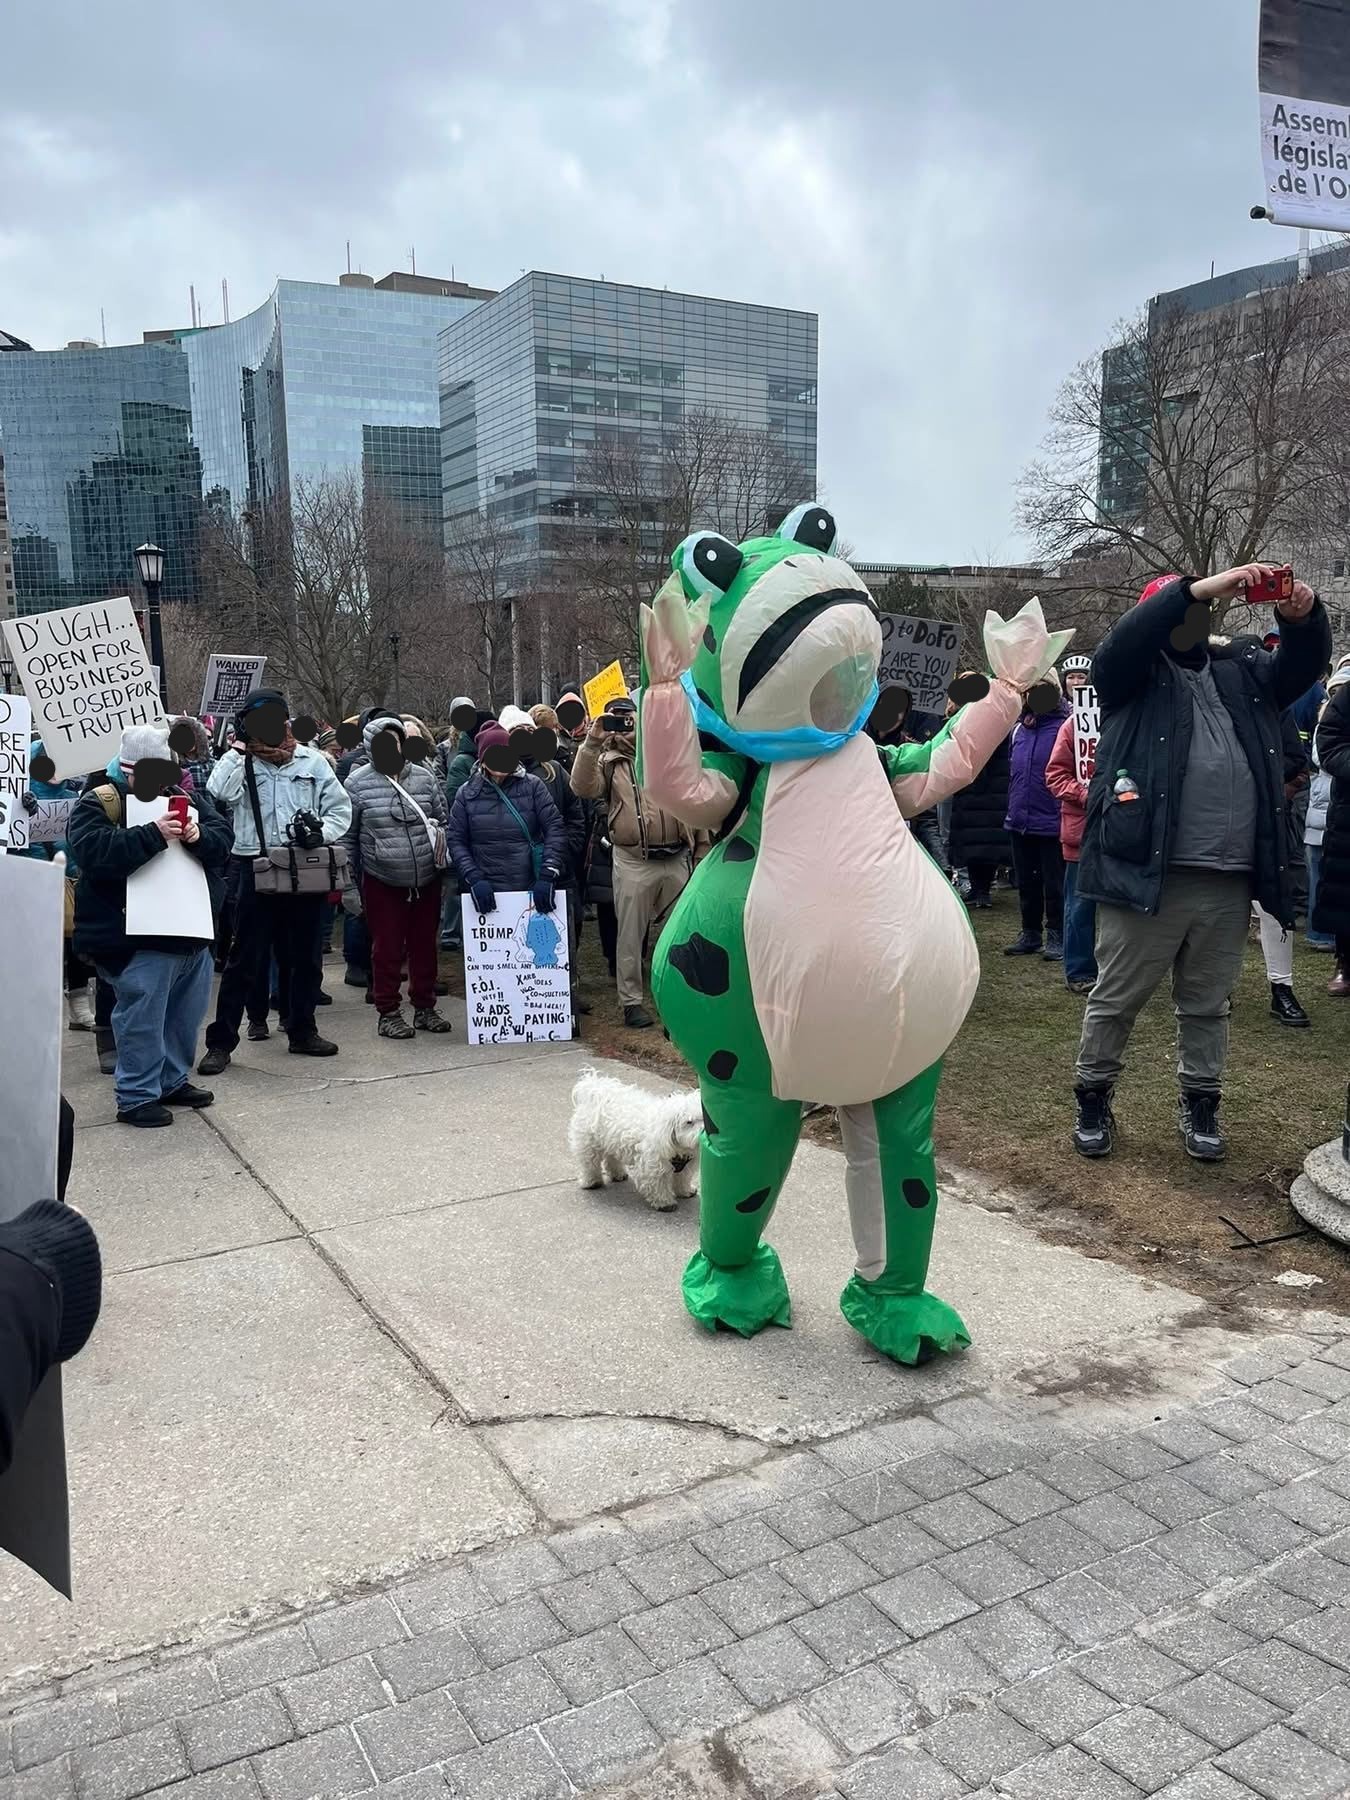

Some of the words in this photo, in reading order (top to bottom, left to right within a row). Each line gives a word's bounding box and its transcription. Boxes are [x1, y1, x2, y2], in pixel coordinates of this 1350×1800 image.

[1272, 104, 1350, 138] Assem
[1278, 169, 1307, 194] de
[1313, 172, 1350, 199] l'O
[898, 621, 913, 638] to
[27, 649, 88, 676] OPEN
[92, 639, 140, 663] FOR
[215, 660, 259, 670] WANTED
[891, 651, 920, 669] ARE
[924, 654, 951, 676] YOU
[34, 659, 144, 699] BUSINESS
[43, 688, 123, 723] CLOSED
[125, 680, 159, 702] FOR
[1076, 713, 1090, 733] IS
[476, 1003, 485, 1013] &
[472, 1016, 498, 1027] WHO
